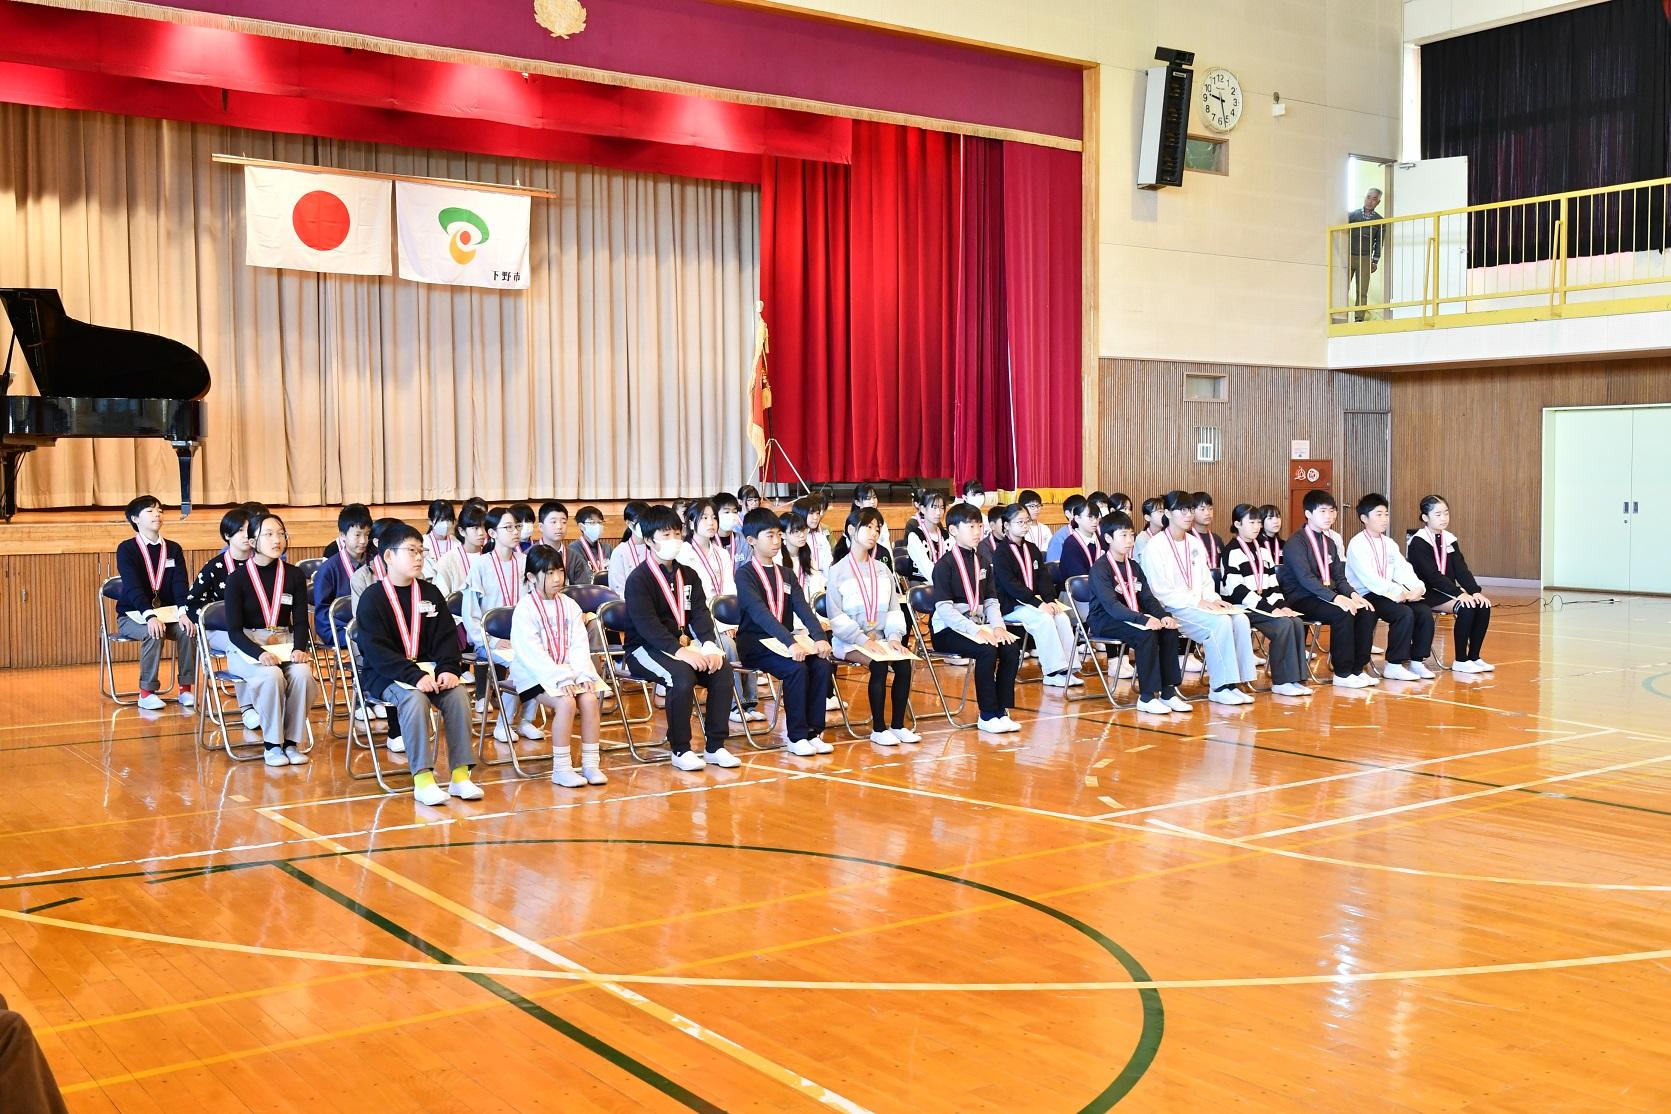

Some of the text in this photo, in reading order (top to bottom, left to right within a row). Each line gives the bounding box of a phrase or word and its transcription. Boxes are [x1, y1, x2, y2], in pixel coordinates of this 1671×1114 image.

[1217, 74, 1224, 82] 12
[1205, 84, 1211, 92] 10
[1231, 87, 1235, 95] 2
[1203, 94, 1207, 102] 9
[1206, 105, 1210, 113] 8
[1212, 113, 1216, 121] 7
[1218, 117, 1222, 125] 6
[491, 270, 520, 282] 下野市
